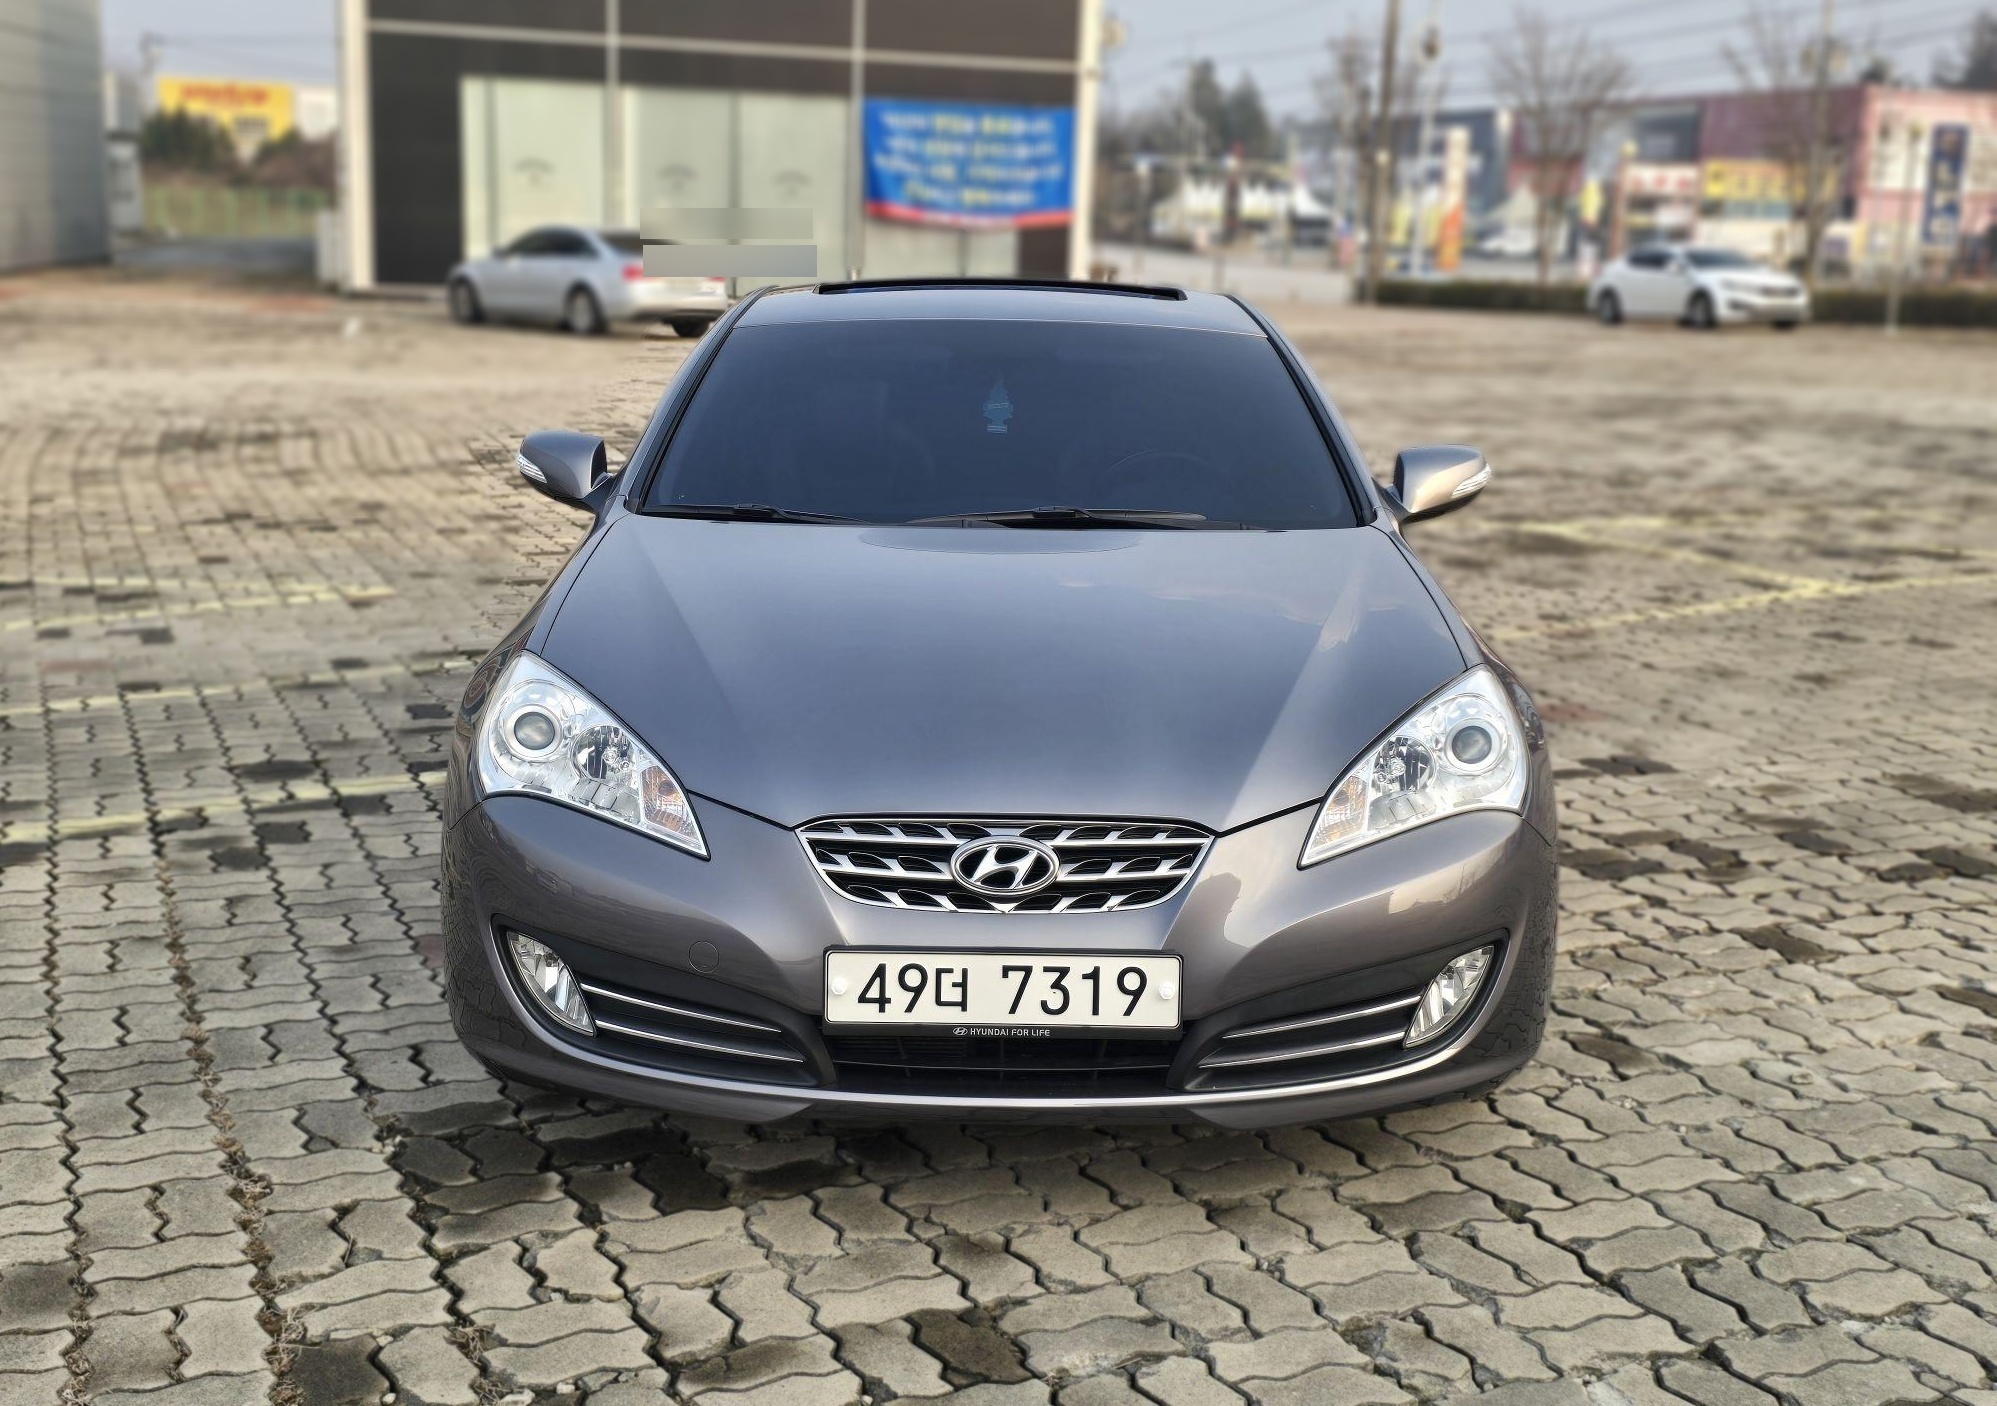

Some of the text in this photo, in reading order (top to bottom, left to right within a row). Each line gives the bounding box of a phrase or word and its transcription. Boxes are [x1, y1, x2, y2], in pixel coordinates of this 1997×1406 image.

[857, 963, 1148, 1017] 49더 7319
[970, 1027, 1051, 1037] HYUNDAI FOR LIFE
